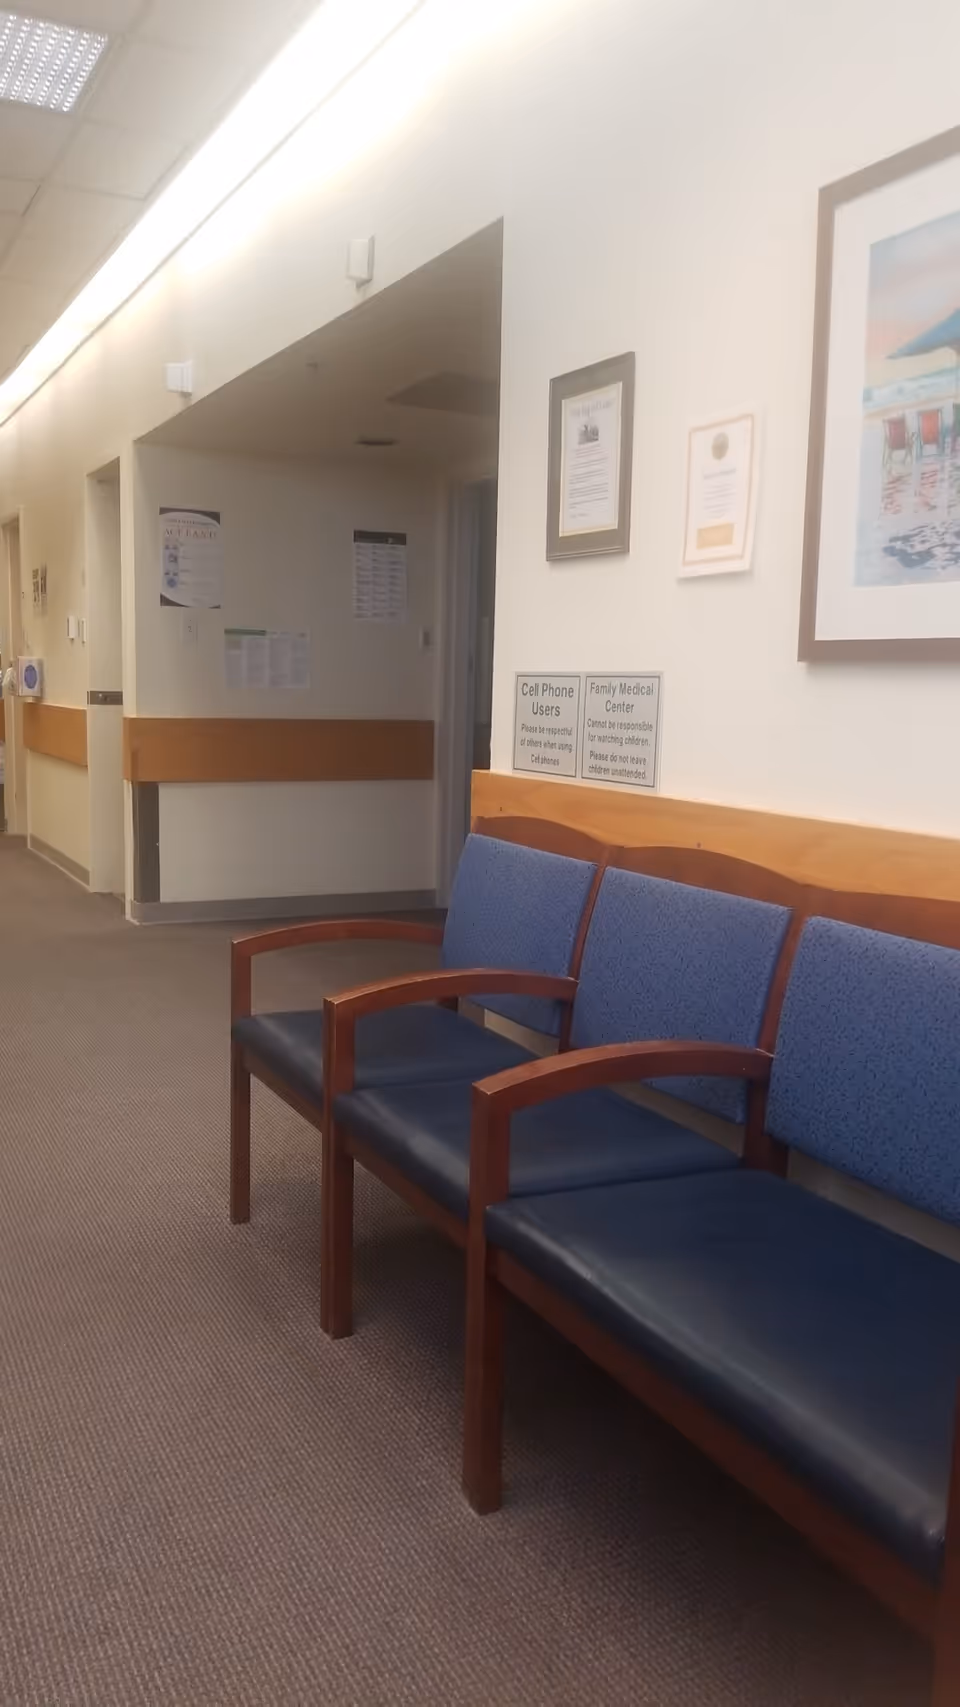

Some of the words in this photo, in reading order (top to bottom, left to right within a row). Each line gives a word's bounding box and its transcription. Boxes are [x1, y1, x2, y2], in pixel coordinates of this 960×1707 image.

[521, 682, 539, 696] Cell
[542, 683, 574, 698] Phone
[590, 682, 617, 698] Family
[619, 682, 654, 696] Medical
[532, 702, 560, 717] Users
[605, 700, 635, 714] Center
[522, 724, 537, 733] Please
[539, 725, 544, 734] be
[546, 726, 572, 737] respectful
[587, 718, 607, 729] Cannot
[609, 720, 616, 729] be
[617, 721, 653, 733] responsible
[520, 738, 526, 746] of
[526, 738, 542, 748] others
[543, 740, 557, 749] when
[558, 742, 572, 753] using
[588, 732, 596, 742] for
[597, 734, 623, 746] watching
[624, 736, 651, 747] children.
[541, 756, 560, 766] phones
[590, 750, 608, 762] Please
[610, 752, 617, 762] do
[619, 754, 629, 763] not
[630, 755, 646, 765] leave
[588, 765, 610, 775] children
